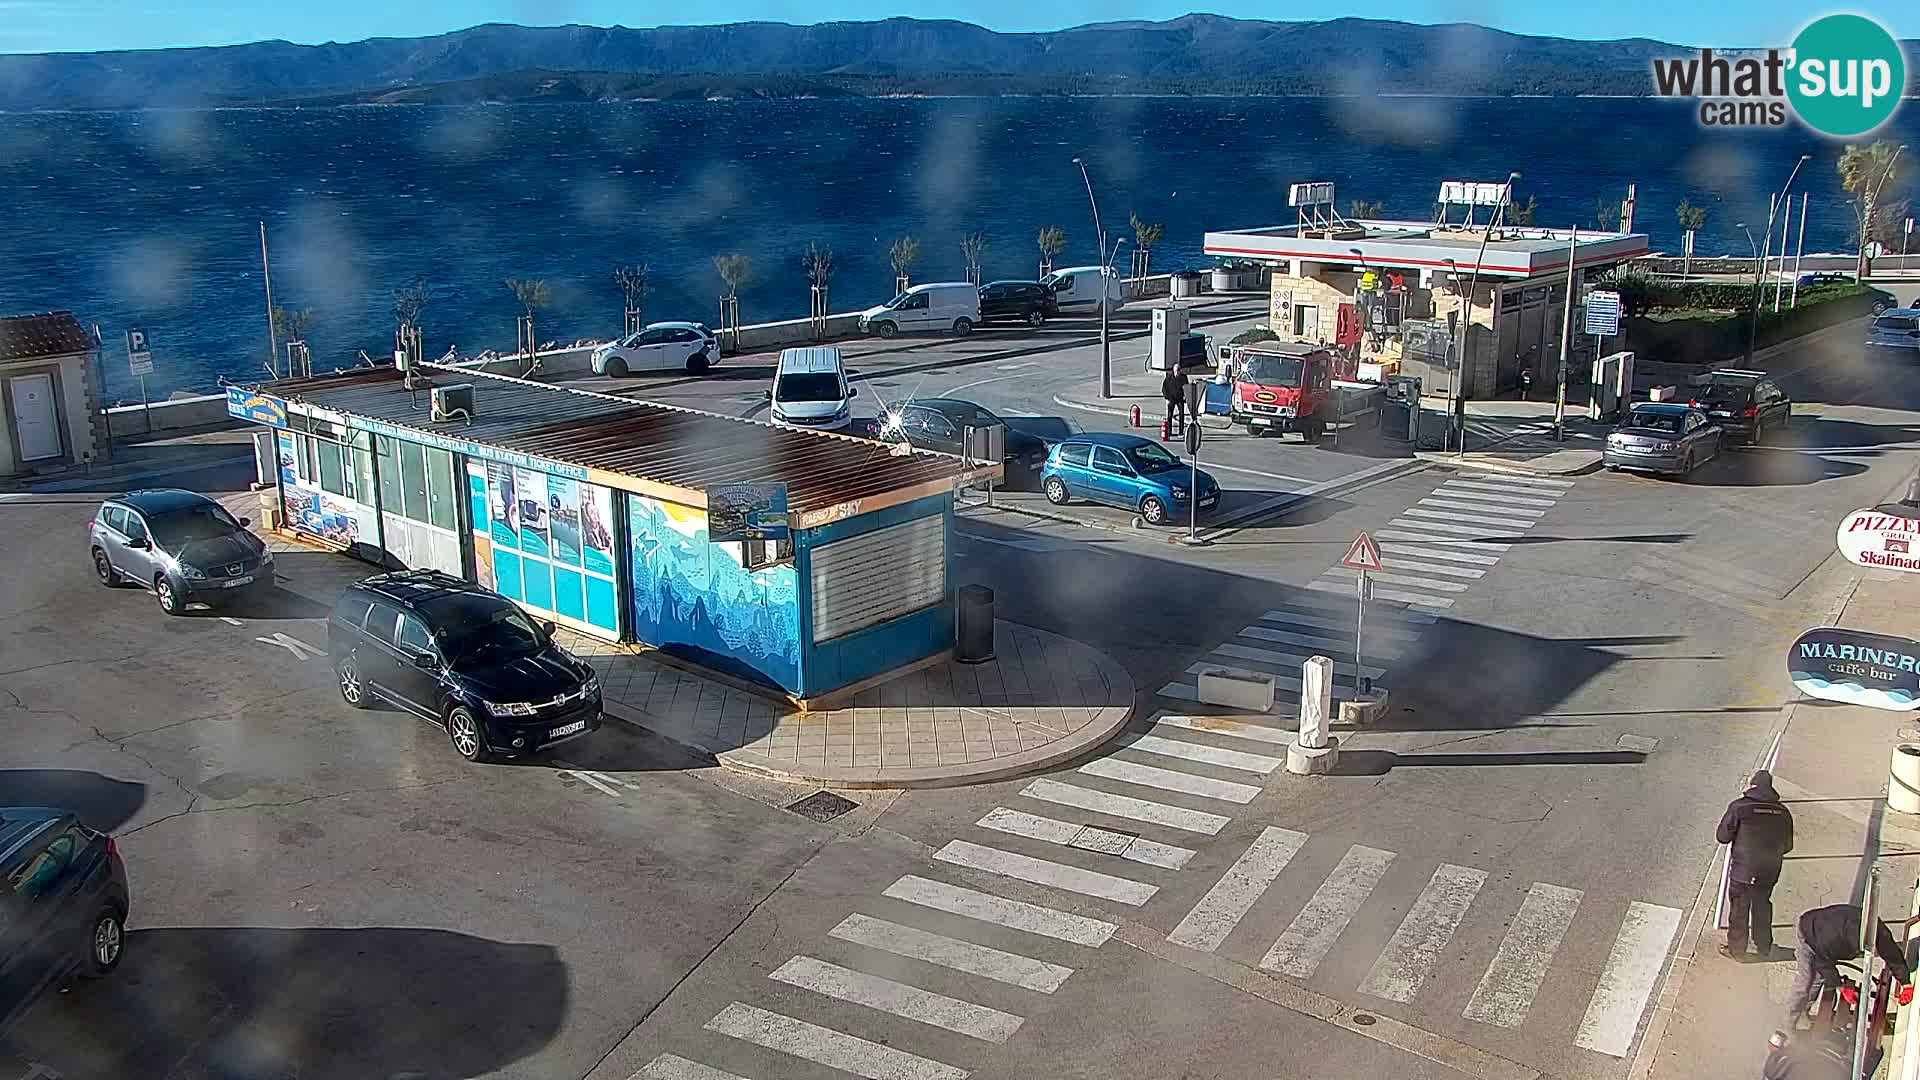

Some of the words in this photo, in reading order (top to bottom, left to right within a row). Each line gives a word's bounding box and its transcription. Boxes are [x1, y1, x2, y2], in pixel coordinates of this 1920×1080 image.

[131, 332, 145, 350] P
[495, 450, 527, 465] STATION
[529, 457, 556, 472] TICKET
[556, 463, 584, 478] OFFICE
[1848, 516, 1920, 535] PIZZE
[1828, 663, 1865, 676] caffe
[1869, 667, 1897, 681] bar
